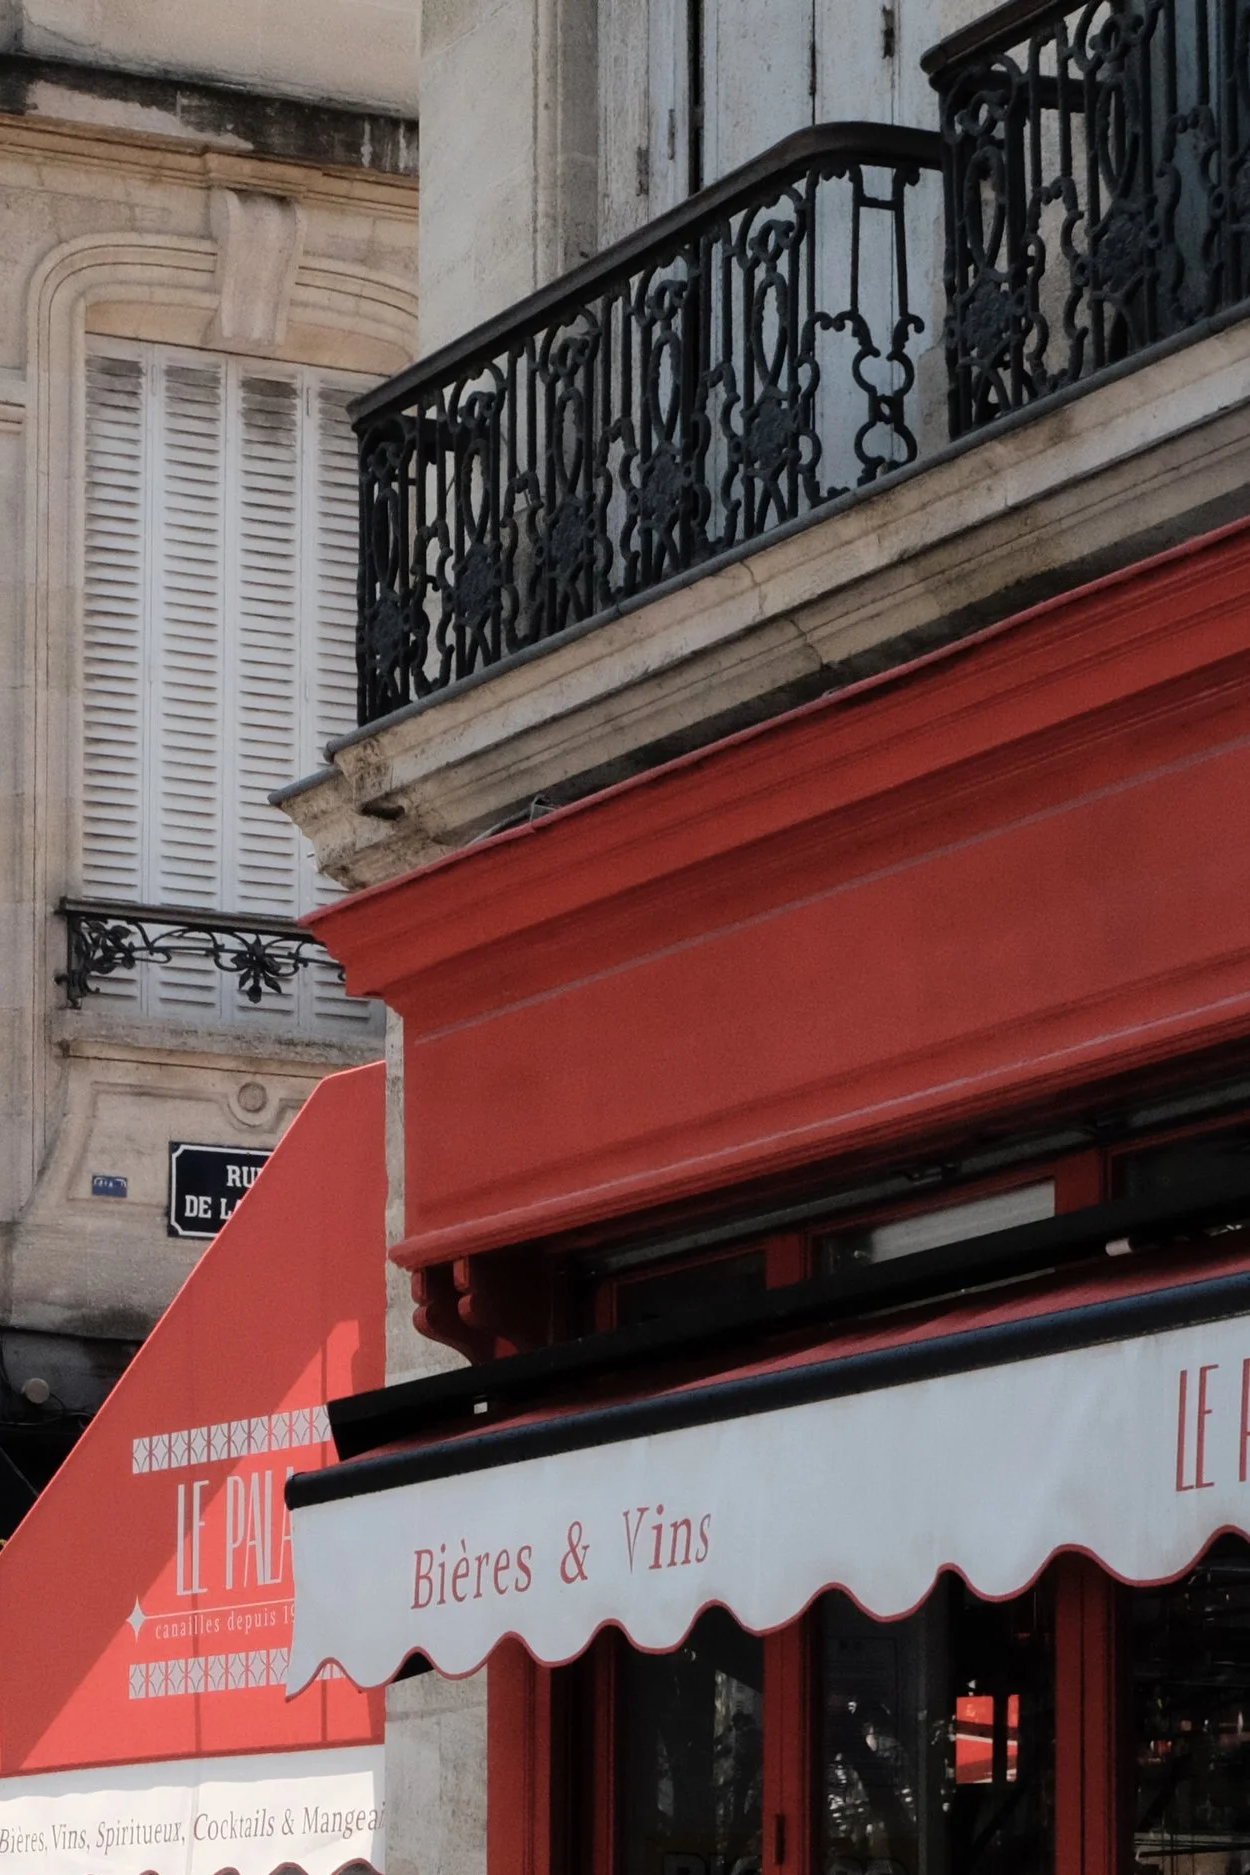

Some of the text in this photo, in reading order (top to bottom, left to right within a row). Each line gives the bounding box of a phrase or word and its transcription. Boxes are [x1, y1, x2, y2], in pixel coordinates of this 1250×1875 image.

[184, 1195, 211, 1218] DE
[1176, 1364, 1219, 1492] LE
[176, 1480, 209, 1596] LE
[411, 1503, 711, 1610] Bières & Vins
[155, 1614, 220, 1639] canailles
[227, 1608, 276, 1634] depuis
[52, 1823, 91, 1856] Vins,
[96, 1818, 186, 1856] Spiritueux,
[193, 1808, 275, 1841] Cocktails
[281, 1808, 294, 1836] &
